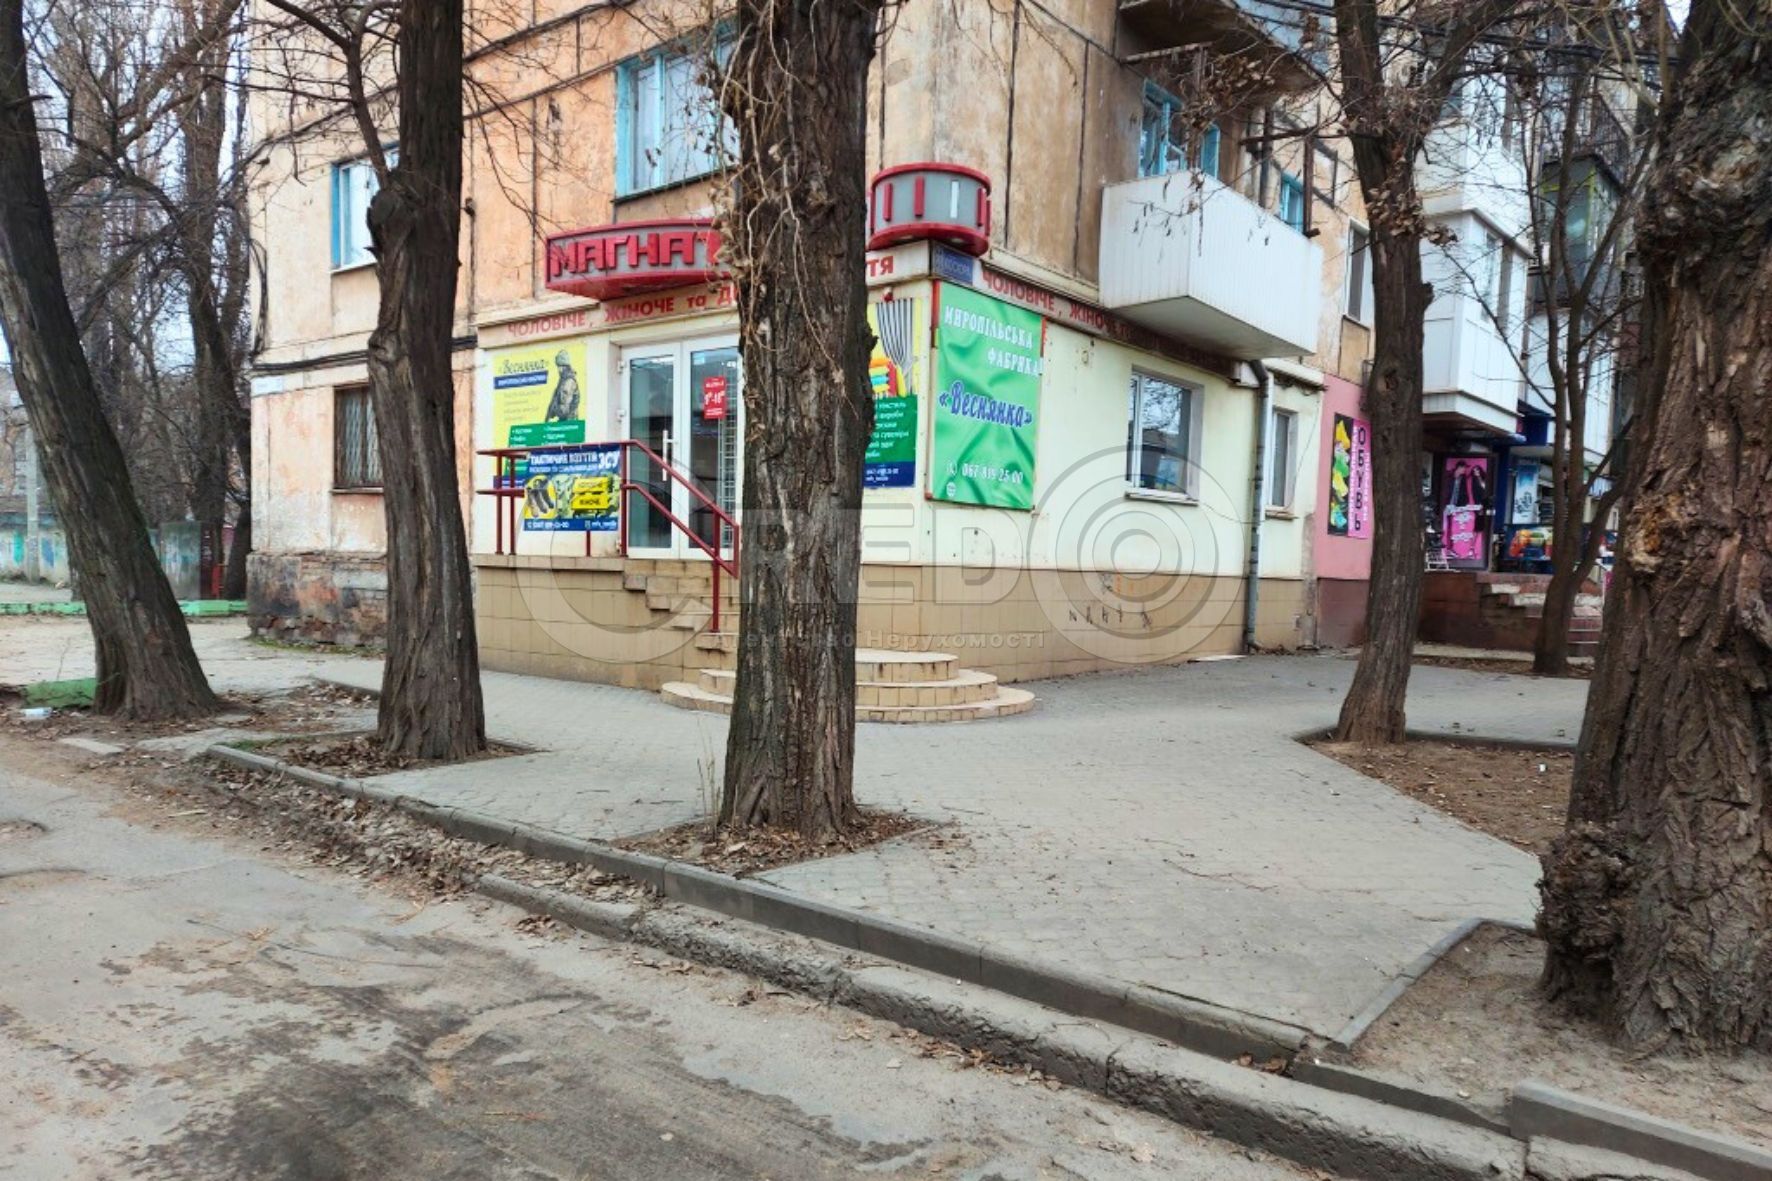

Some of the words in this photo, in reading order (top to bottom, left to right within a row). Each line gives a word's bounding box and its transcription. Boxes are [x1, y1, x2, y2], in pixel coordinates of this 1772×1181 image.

[604, 296, 675, 323] ЖІНОЧЕ
[1069, 302, 1119, 333] ЖІНОЧЕ
[987, 346, 1045, 376] ФАБРИКА
[939, 379, 1033, 428] «Веснянка»
[1354, 426, 1367, 531] ОБУВЬ
